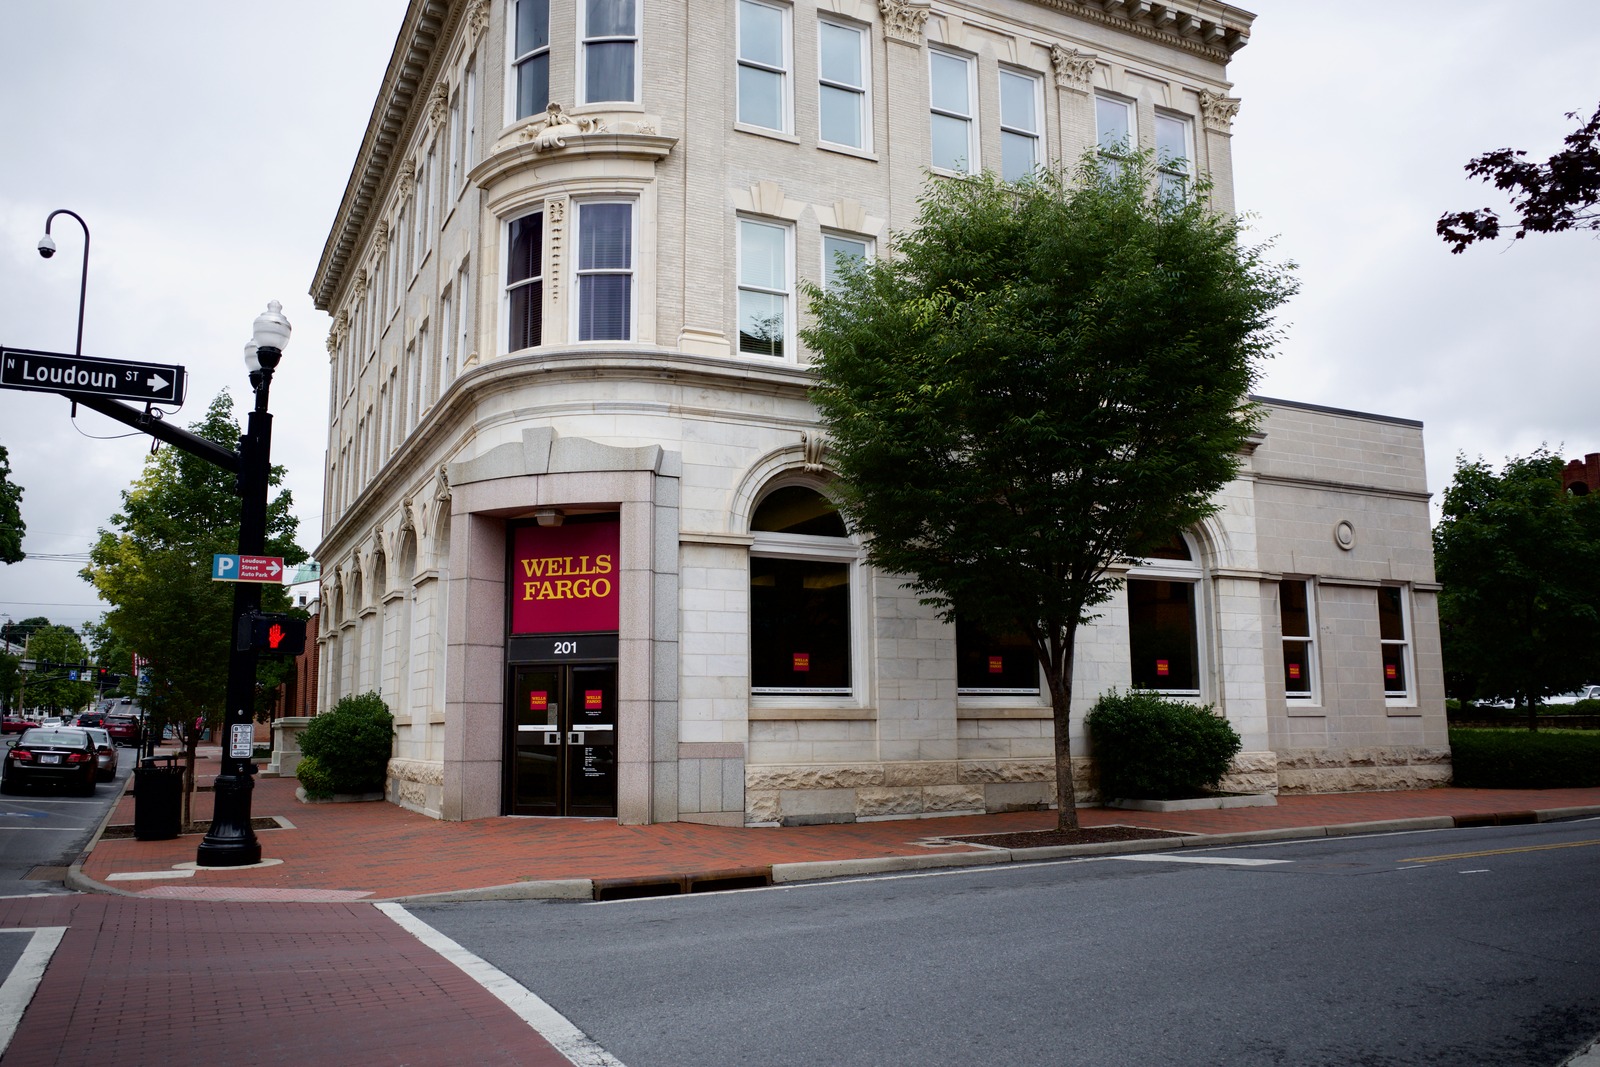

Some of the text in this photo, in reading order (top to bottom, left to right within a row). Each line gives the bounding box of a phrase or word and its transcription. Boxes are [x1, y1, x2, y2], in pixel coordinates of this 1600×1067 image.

[7, 358, 139, 388] N Loudoun ST
[218, 557, 234, 576] P
[521, 554, 612, 578] WELLS
[523, 578, 611, 601] FARGO
[554, 641, 577, 655] 201
